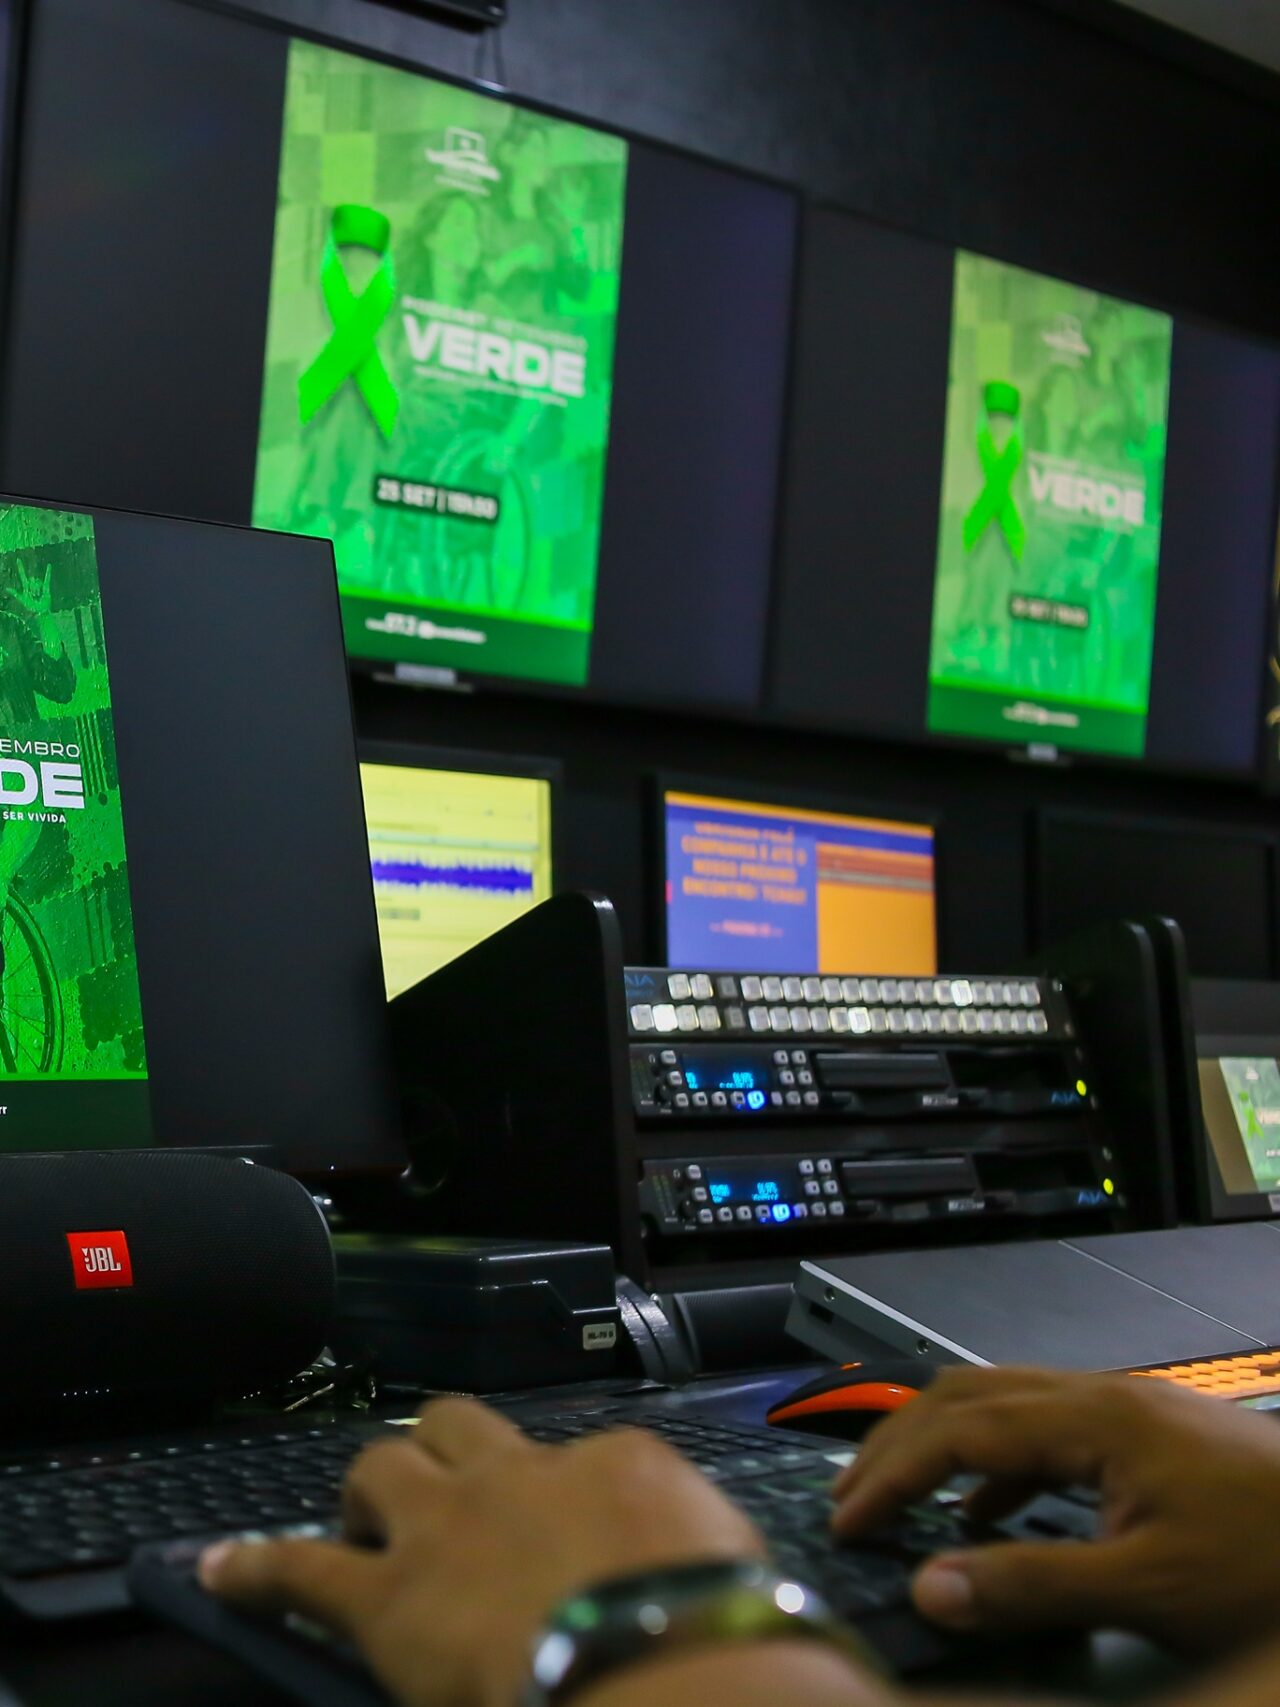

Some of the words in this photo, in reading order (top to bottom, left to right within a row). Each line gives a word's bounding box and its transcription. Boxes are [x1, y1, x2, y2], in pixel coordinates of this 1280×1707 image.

[403, 314, 586, 398] VERDE
[3, 810, 24, 822] SER
[28, 813, 66, 824] VIVIDA
[81, 1247, 121, 1272] JBL
